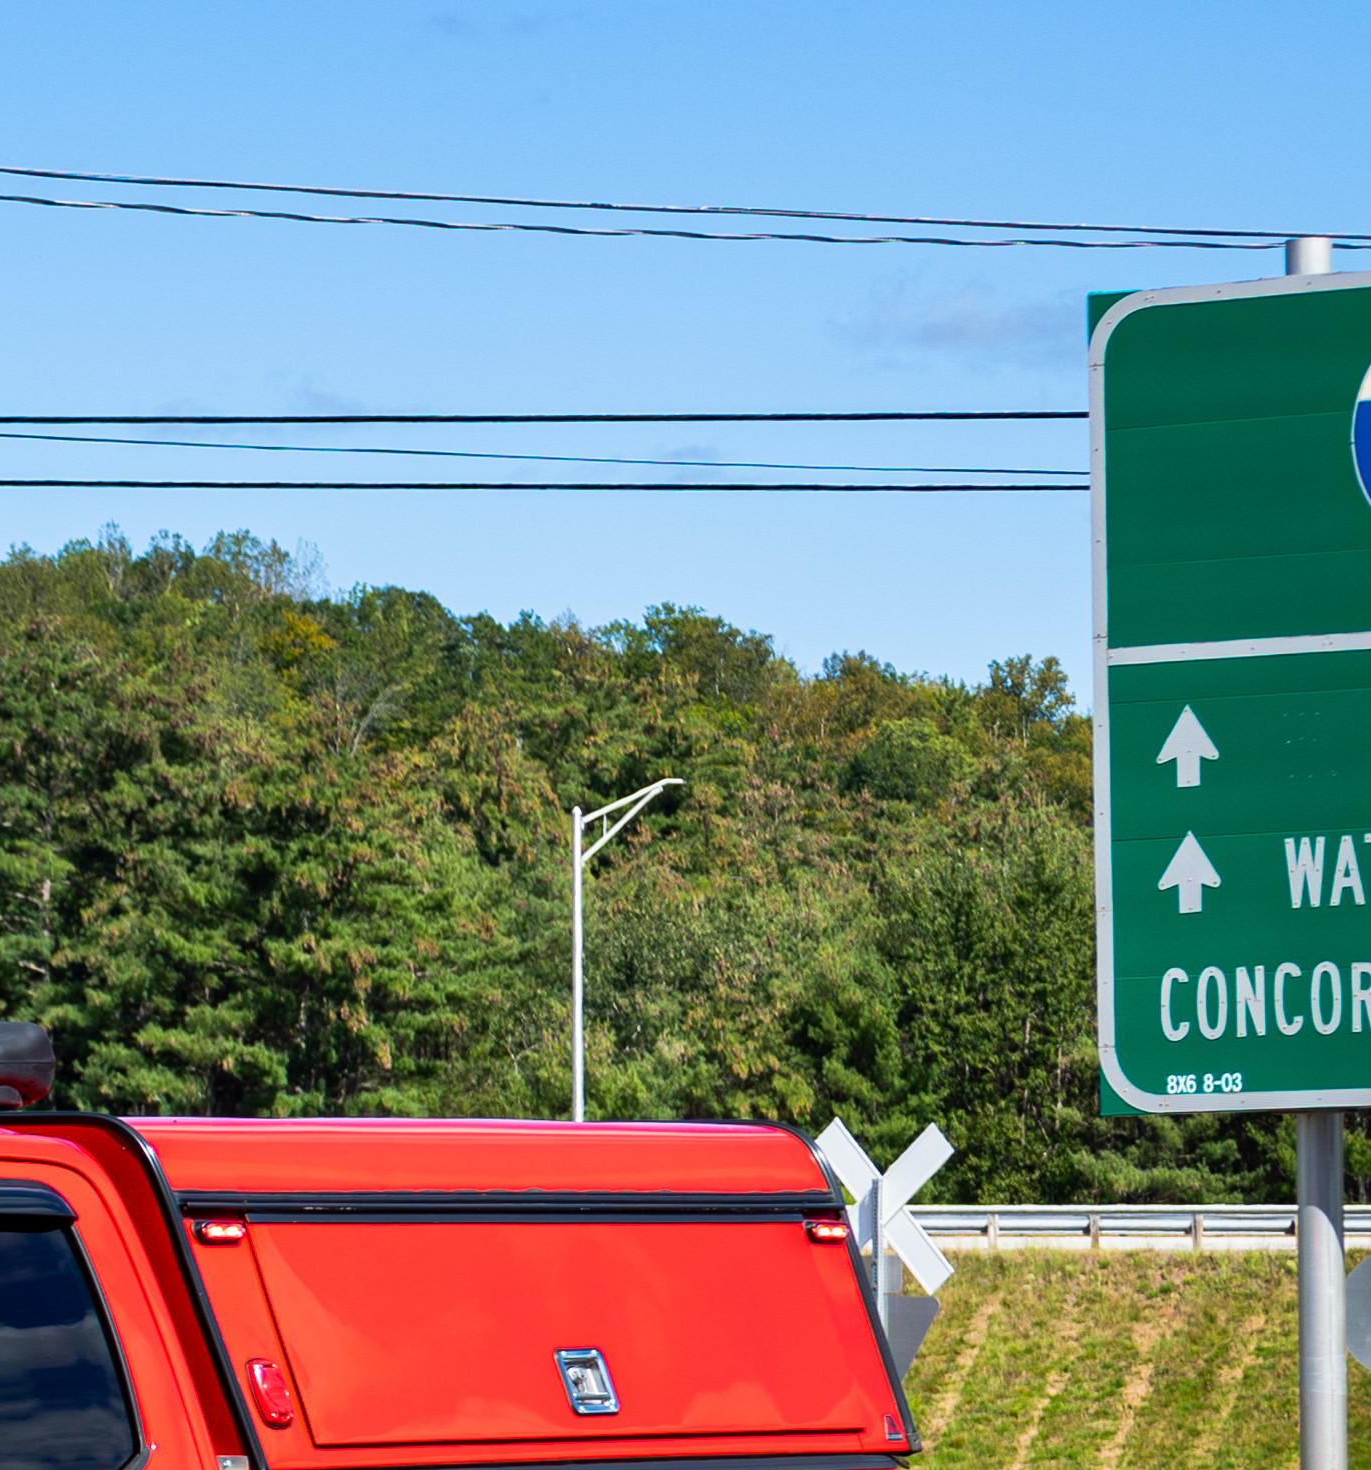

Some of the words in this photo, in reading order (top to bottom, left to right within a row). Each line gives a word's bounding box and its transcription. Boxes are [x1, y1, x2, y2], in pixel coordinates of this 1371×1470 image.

[1284, 833, 1371, 909] WA
[1166, 1074, 1198, 1095] 8X6
[1202, 1072, 1242, 1093] 8-03
